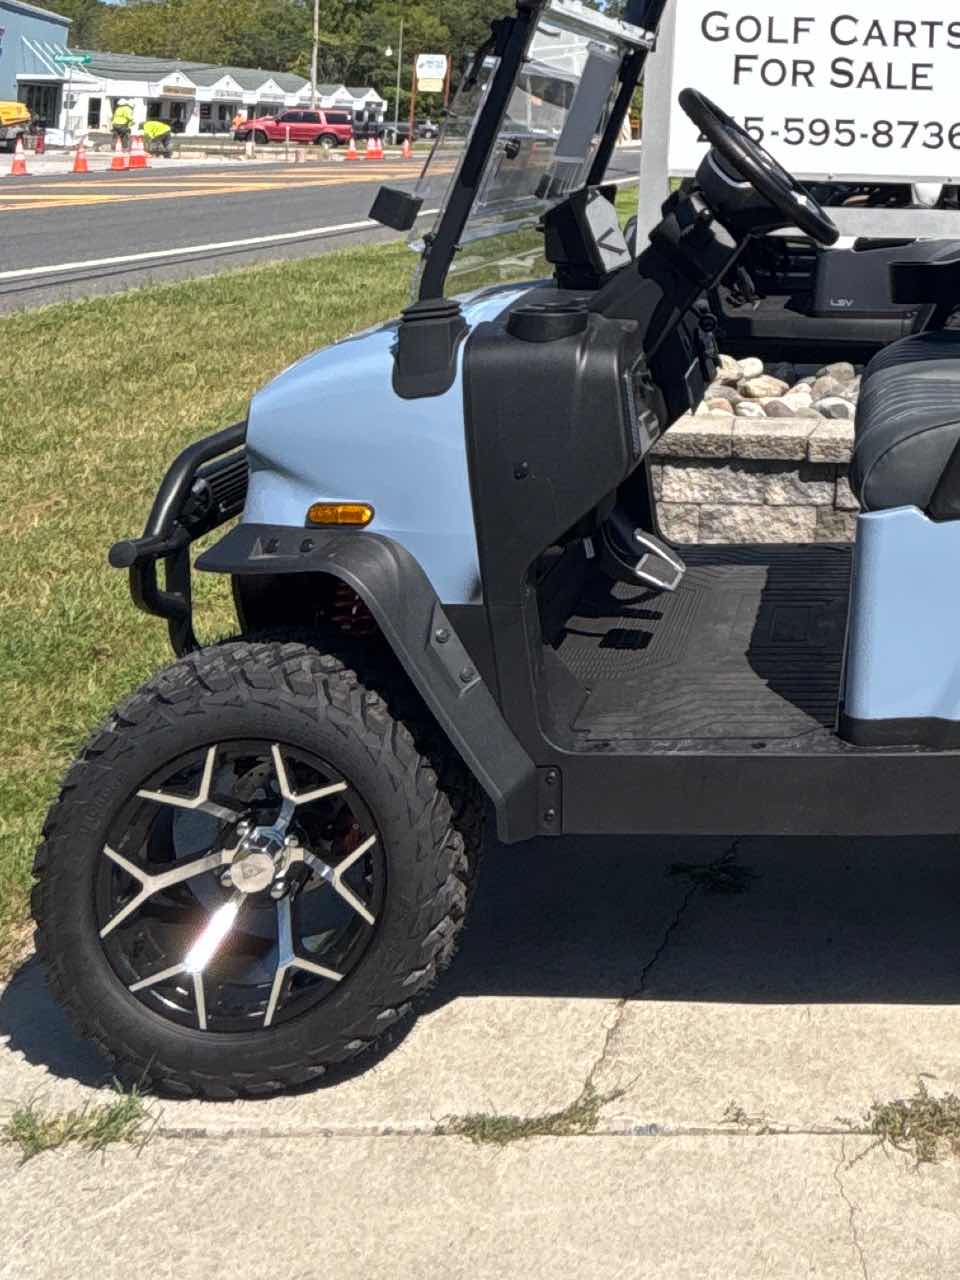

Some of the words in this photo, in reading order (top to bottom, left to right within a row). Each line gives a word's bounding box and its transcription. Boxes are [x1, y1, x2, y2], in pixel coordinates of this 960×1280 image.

[701, 10, 816, 44] GOLF
[732, 54, 816, 88] FOR
[829, 56, 934, 91] SALE
